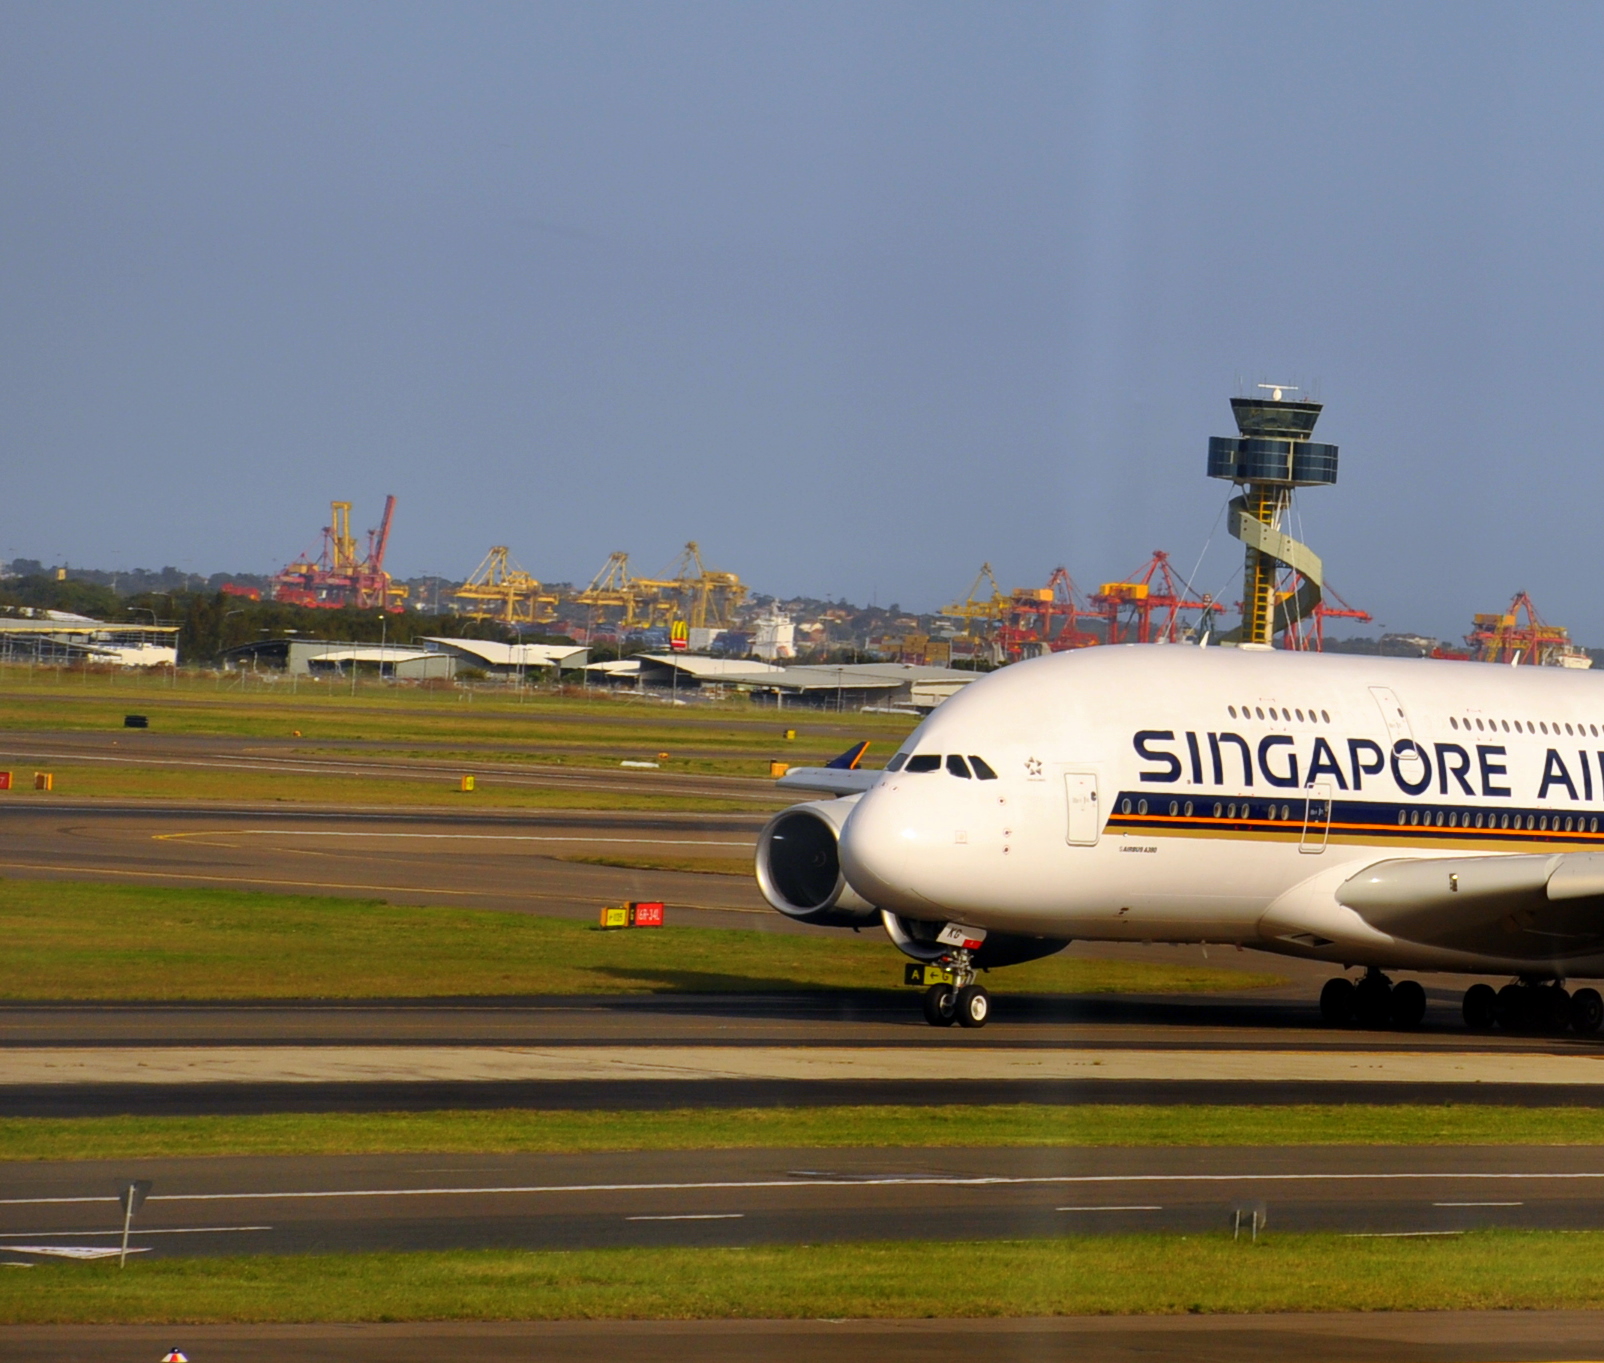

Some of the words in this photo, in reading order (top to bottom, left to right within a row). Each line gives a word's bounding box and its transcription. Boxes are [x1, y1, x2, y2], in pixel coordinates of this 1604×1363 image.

[1133, 730, 1513, 797] SINGAPORE
[946, 926, 963, 939] KG
[911, 969, 920, 980] A
